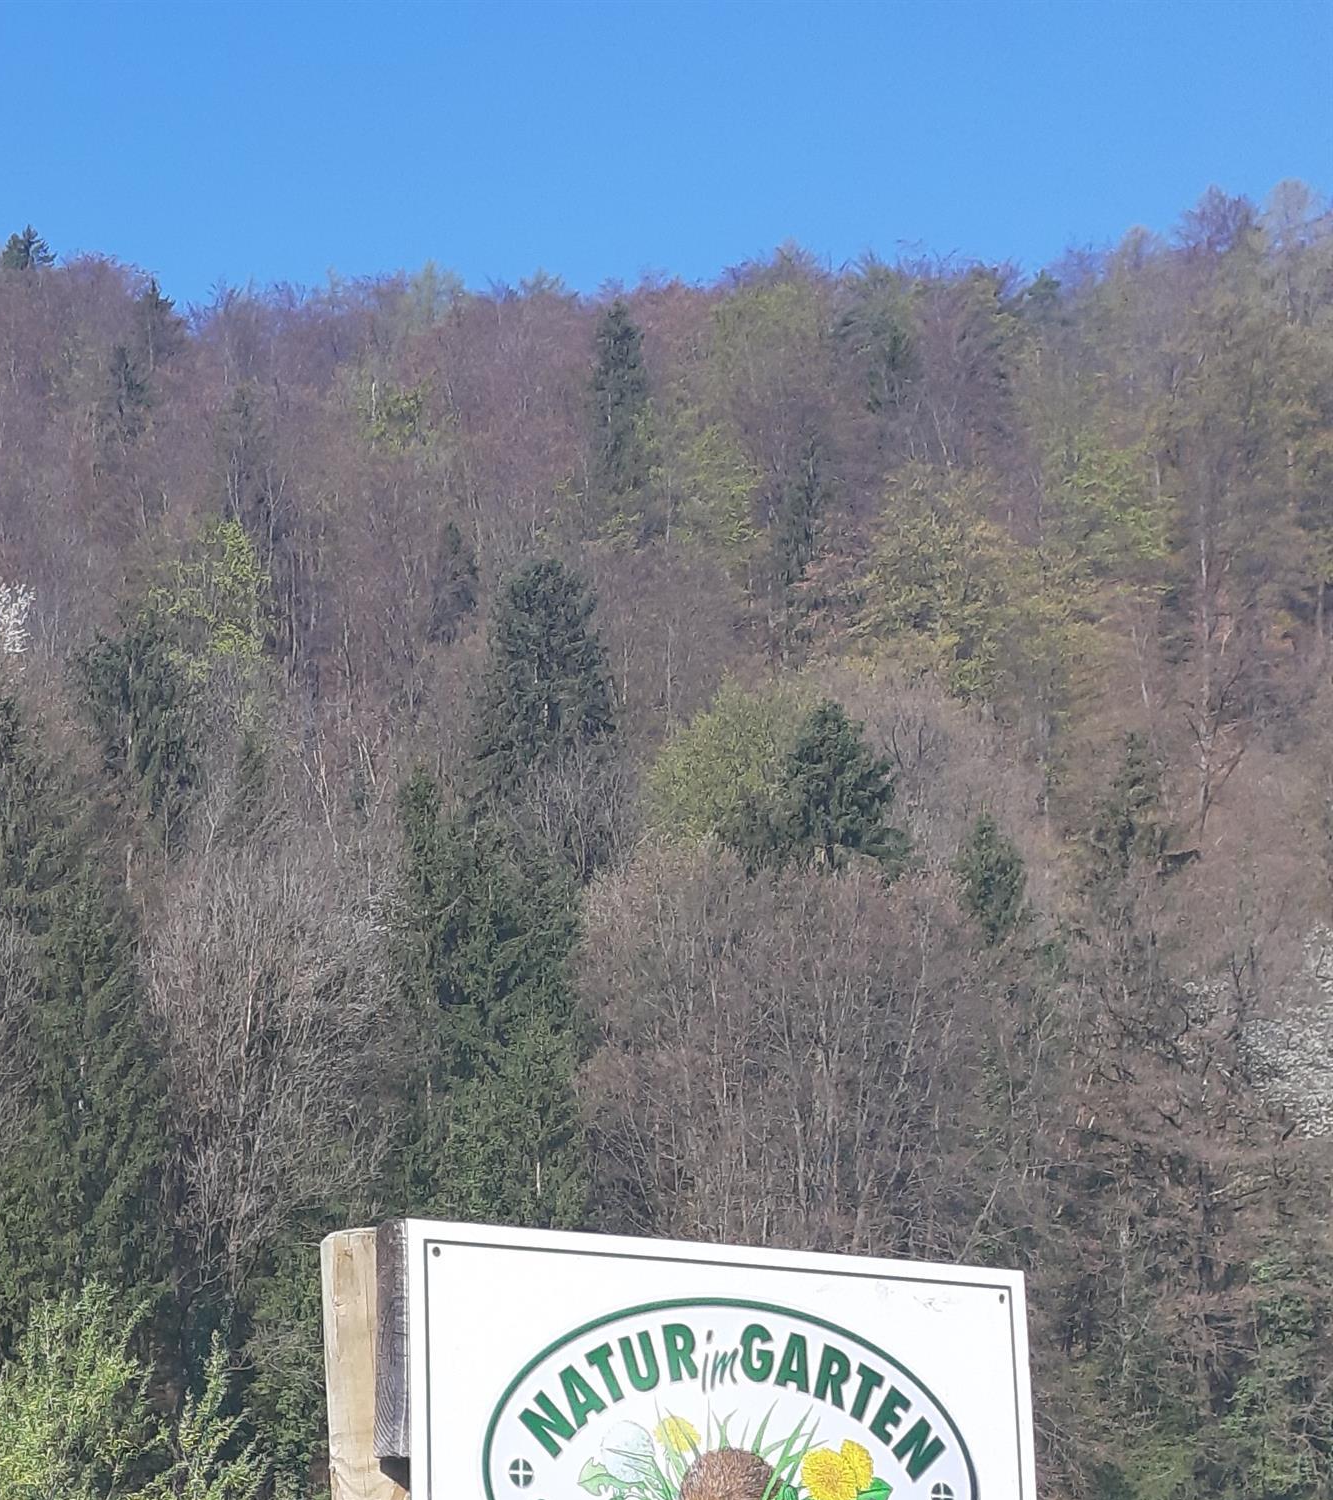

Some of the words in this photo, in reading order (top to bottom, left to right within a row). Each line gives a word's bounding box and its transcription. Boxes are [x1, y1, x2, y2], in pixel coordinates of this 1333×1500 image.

[518, 1322, 698, 1459] NATUR
[701, 1330, 739, 1394] im
[740, 1322, 947, 1483] GARTEN
